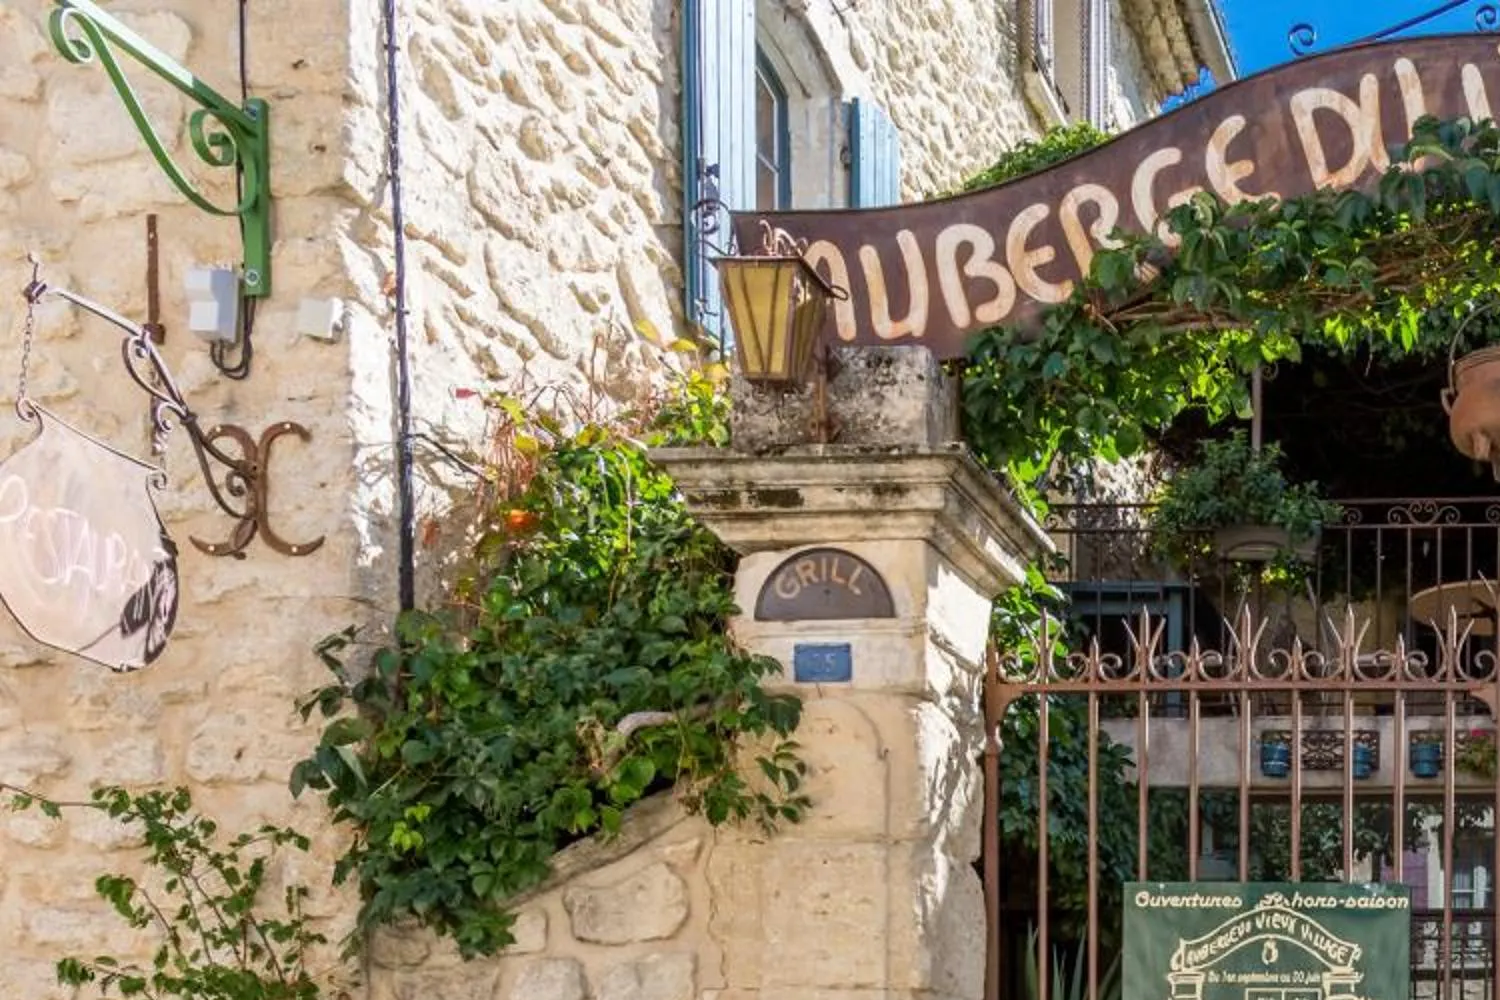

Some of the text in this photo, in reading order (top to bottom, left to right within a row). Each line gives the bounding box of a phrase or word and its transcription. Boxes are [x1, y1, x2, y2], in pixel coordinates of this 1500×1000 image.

[1289, 57, 1427, 191] DU
[775, 557, 864, 599] GRILL
[1134, 890, 1409, 910] Ouvertures hors-saison
